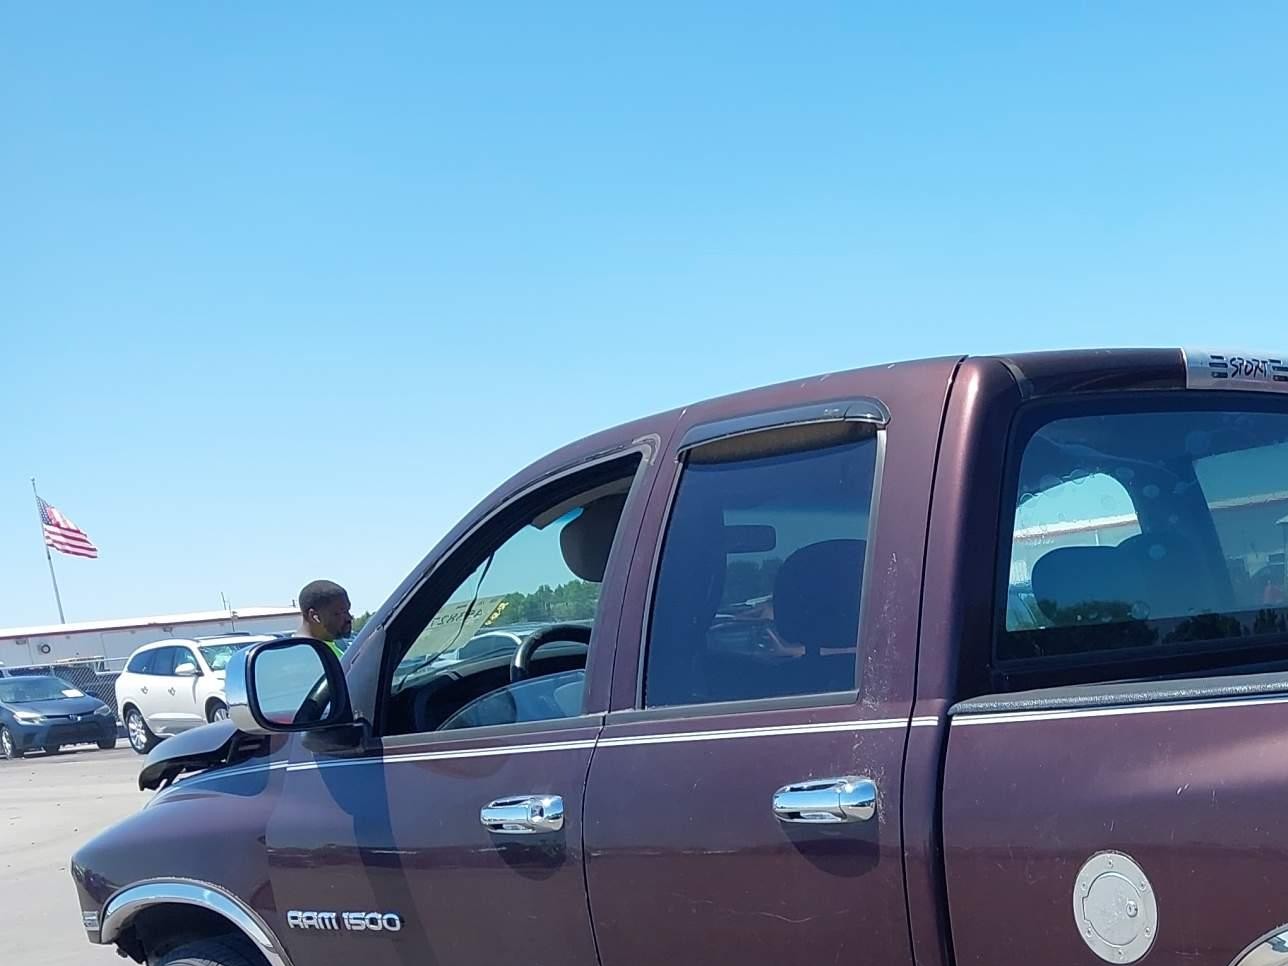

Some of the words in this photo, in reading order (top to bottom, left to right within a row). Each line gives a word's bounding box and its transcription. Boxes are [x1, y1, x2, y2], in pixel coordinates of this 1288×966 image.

[1230, 357, 1268, 378] SPORT
[287, 910, 339, 930] RAM
[342, 911, 401, 931] 1500
